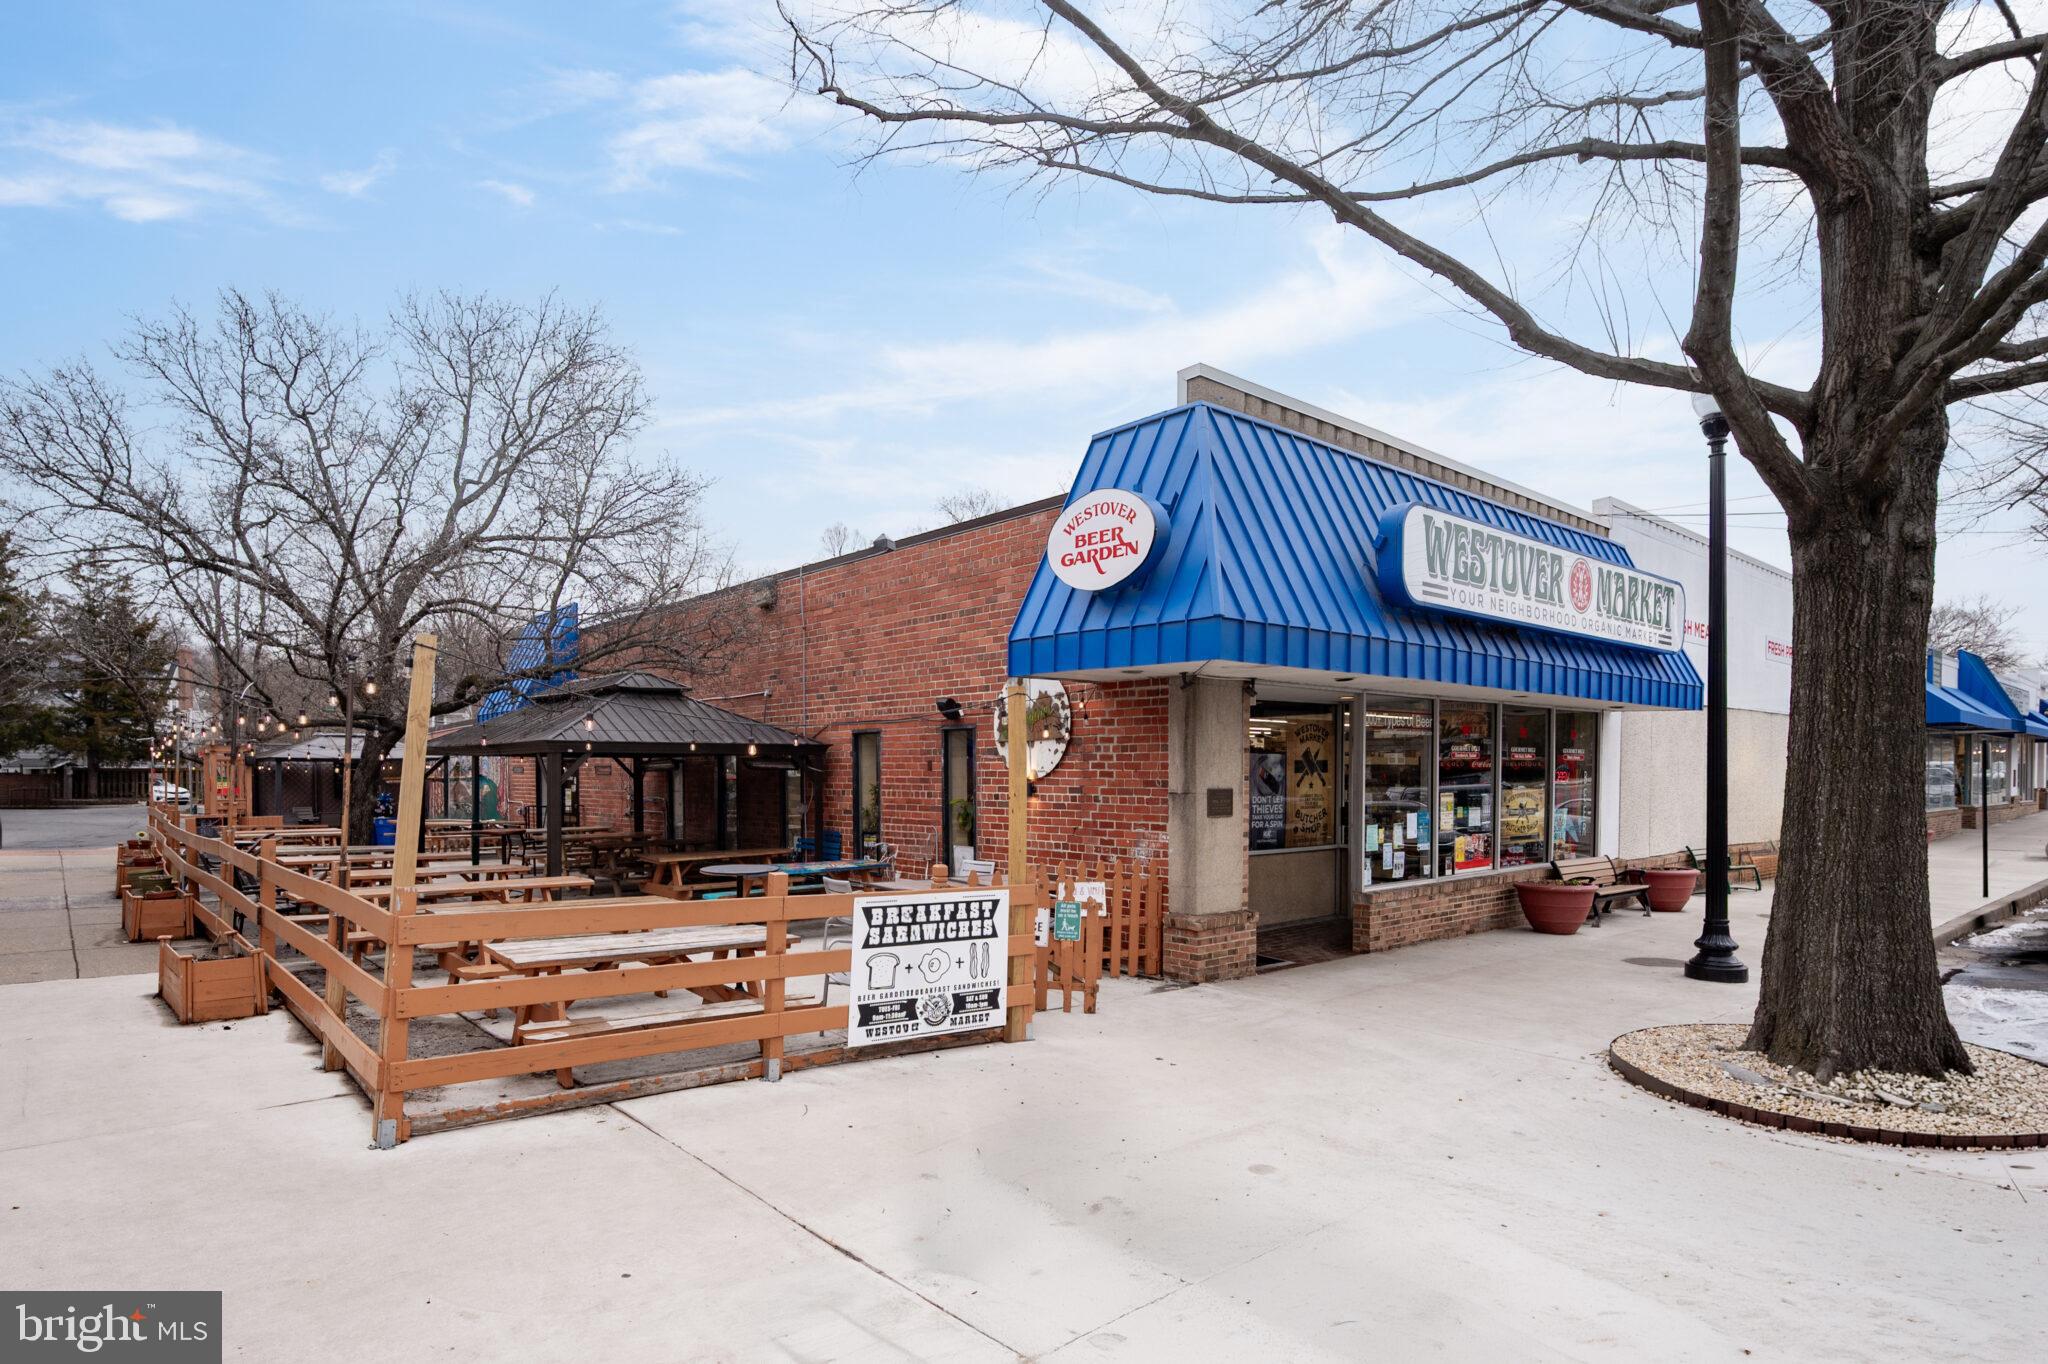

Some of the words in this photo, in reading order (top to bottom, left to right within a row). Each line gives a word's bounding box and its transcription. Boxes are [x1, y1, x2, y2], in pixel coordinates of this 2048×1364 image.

[1063, 501, 1137, 537] WESTOVER
[1075, 526, 1126, 549] BEER
[1060, 540, 1139, 574] GARDEN
[1422, 513, 1565, 609] WESTOVER
[1596, 566, 1675, 632] MARKET
[1449, 588, 1484, 609] YOUR
[1490, 595, 1577, 627] NEIGHBORHOOD
[1581, 618, 1622, 638] ORGANIC
[1625, 629, 1659, 644] MARKET
[1415, 715, 1433, 727] Beer
[1252, 795, 1273, 804] DON'T
[1273, 795, 1283, 804] LET
[1252, 804, 1284, 814] THIEVES
[1295, 808, 1328, 823] BUTCHER
[1269, 820, 1283, 828] SPIN
[1300, 822, 1321, 834] SHOP
[870, 901, 993, 926] BREAKFAST
[857, 993, 876, 1002] BEER
[950, 1012, 991, 1026] MARKET
